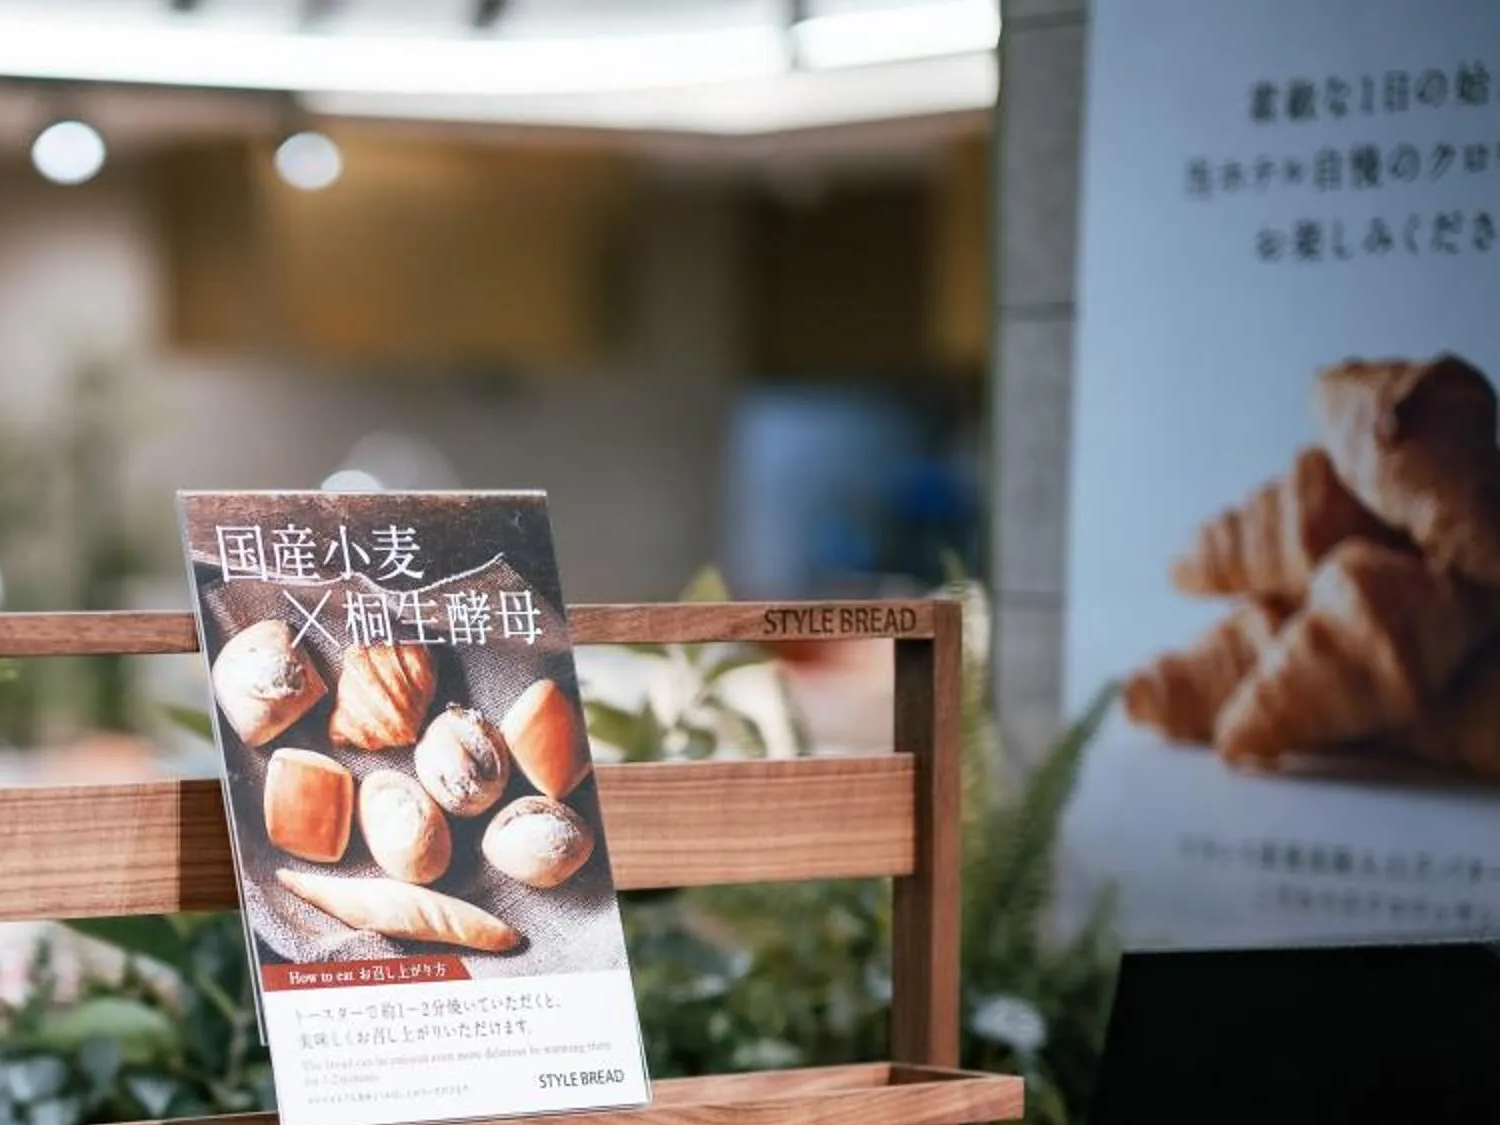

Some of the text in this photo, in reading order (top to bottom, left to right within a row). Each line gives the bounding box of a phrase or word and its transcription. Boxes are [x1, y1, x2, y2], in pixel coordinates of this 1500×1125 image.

[216, 524, 424, 582] 国産小麦
[763, 607, 917, 634] STYLE BREAD
[288, 970, 317, 985] How
[321, 971, 333, 983] to
[359, 961, 447, 981] お召し上がり方
[538, 1069, 625, 1089] STYLE BREAD
